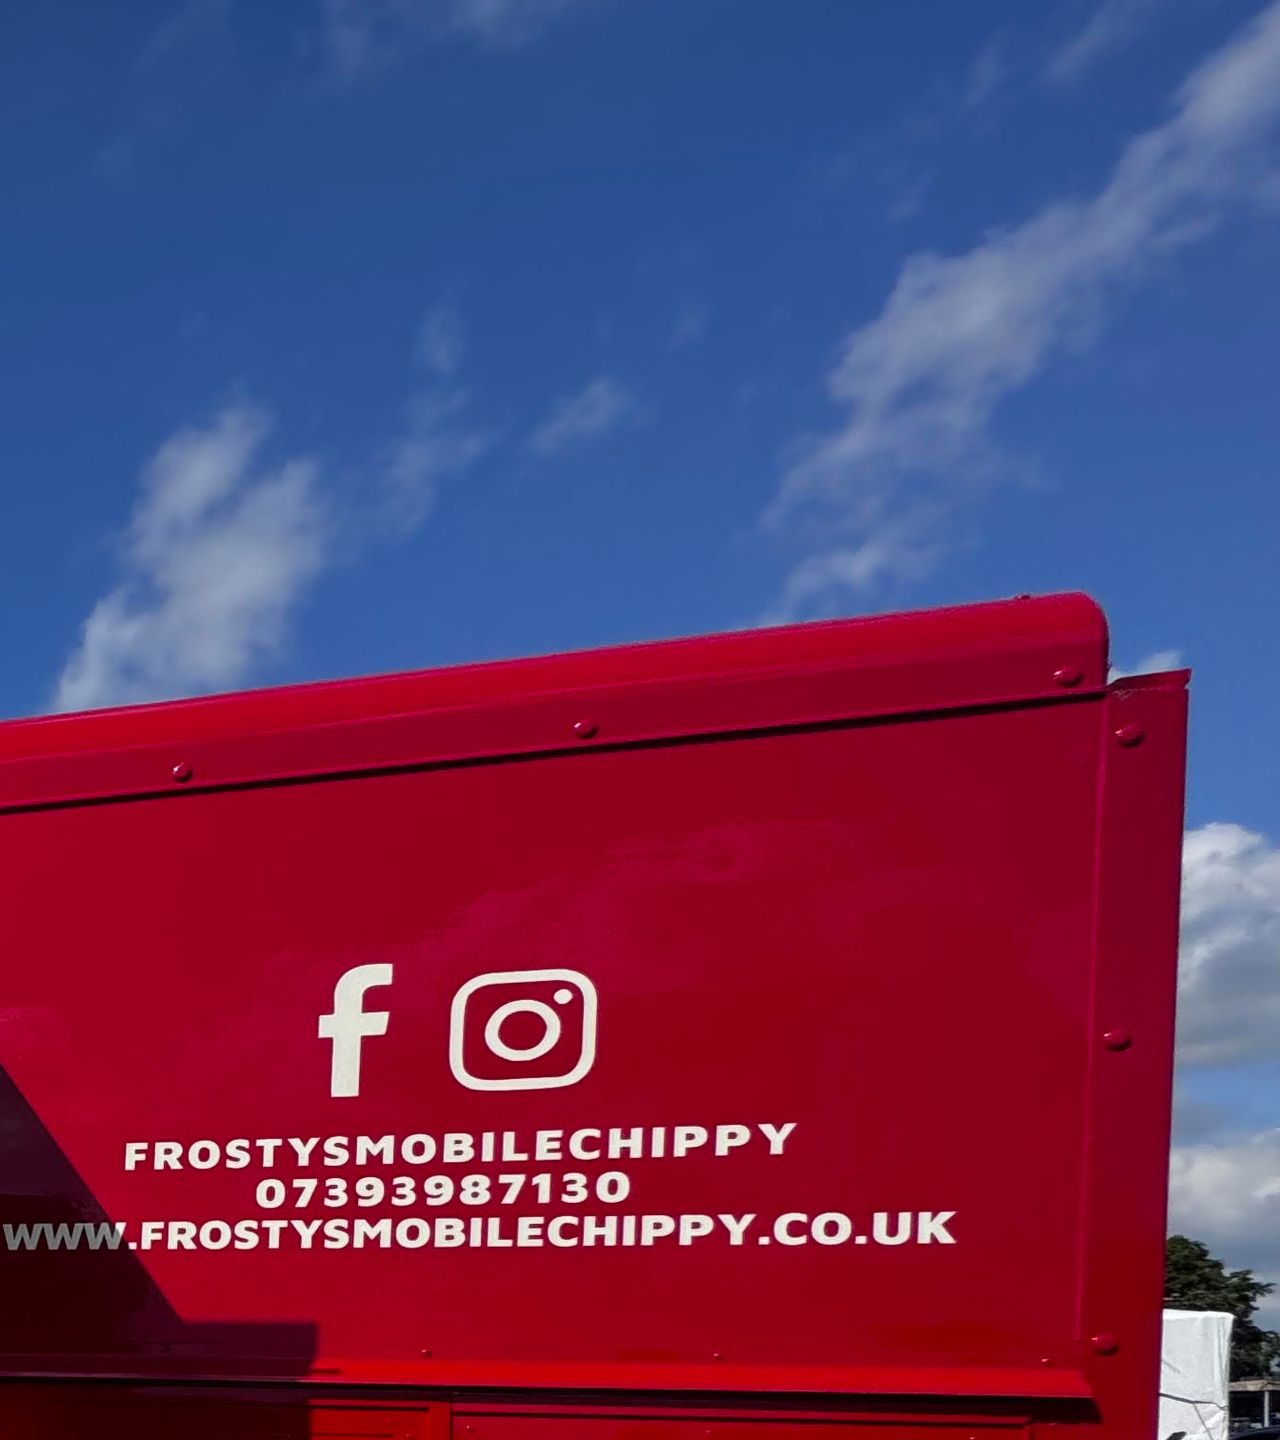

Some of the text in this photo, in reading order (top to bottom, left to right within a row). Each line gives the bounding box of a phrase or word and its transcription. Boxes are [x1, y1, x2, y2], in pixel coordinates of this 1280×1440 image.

[125, 1123, 797, 1171] FROSTYSMOBILECHIPPY
[257, 1171, 630, 1208] 07393987130
[3, 1211, 957, 1250] WWW.FROSTYSMOBILECHIPPY.CO.UK
